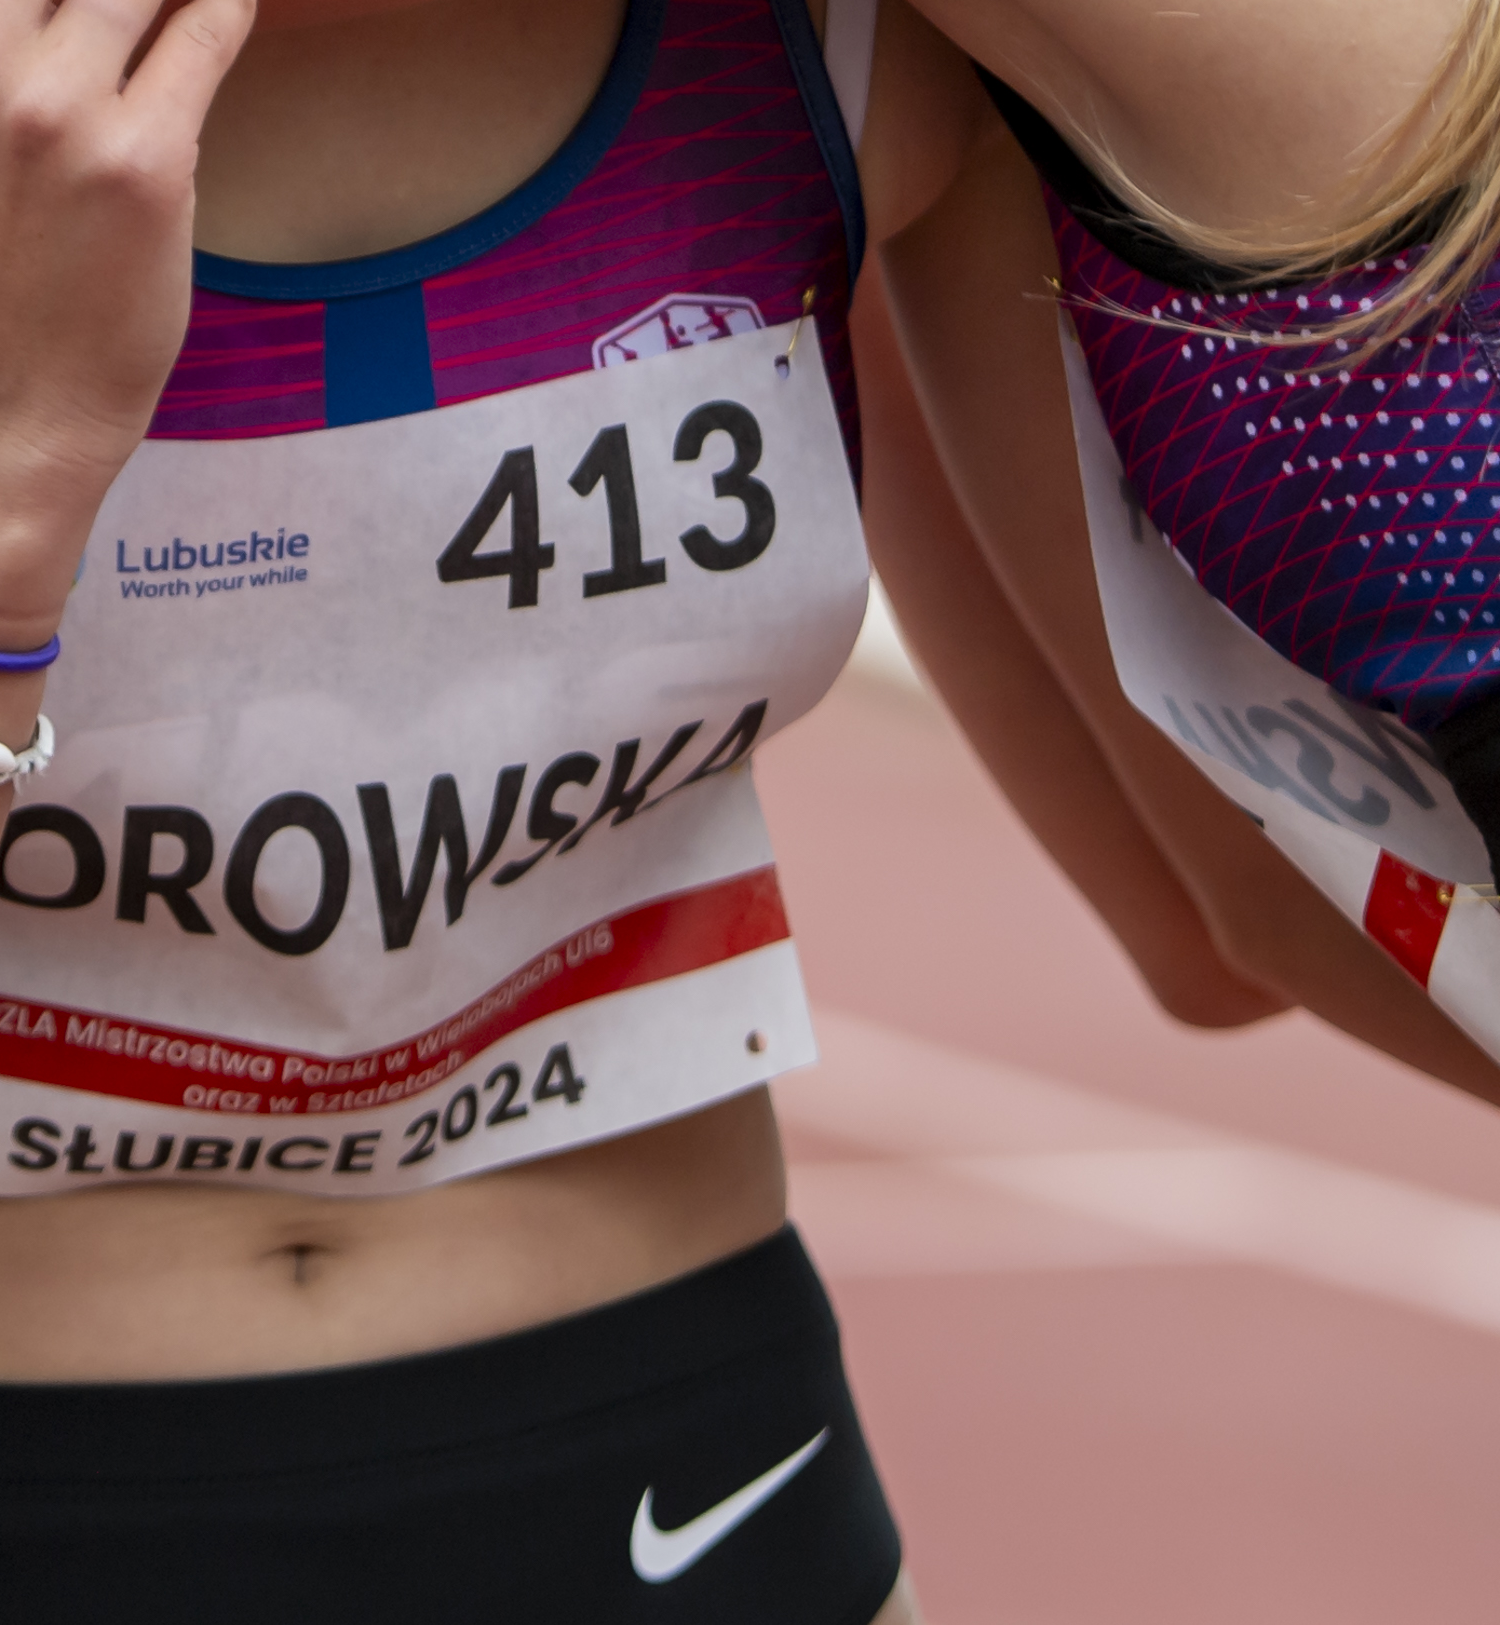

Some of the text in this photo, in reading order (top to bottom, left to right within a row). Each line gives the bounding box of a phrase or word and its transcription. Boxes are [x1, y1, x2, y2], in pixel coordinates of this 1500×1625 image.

[115, 527, 310, 573] Lubuskie
[435, 398, 777, 610] 413
[120, 565, 308, 599] Worth your while
[63, 1014, 276, 1081] Mistrzostwa
[281, 1055, 380, 1087] Polski
[385, 1049, 412, 1073] w
[415, 948, 566, 1060] Wielobojach
[565, 924, 615, 968] U16
[7, 1040, 587, 1174] SŁUBICE 2024
[181, 1049, 464, 1114] oraz w Sztafetach
